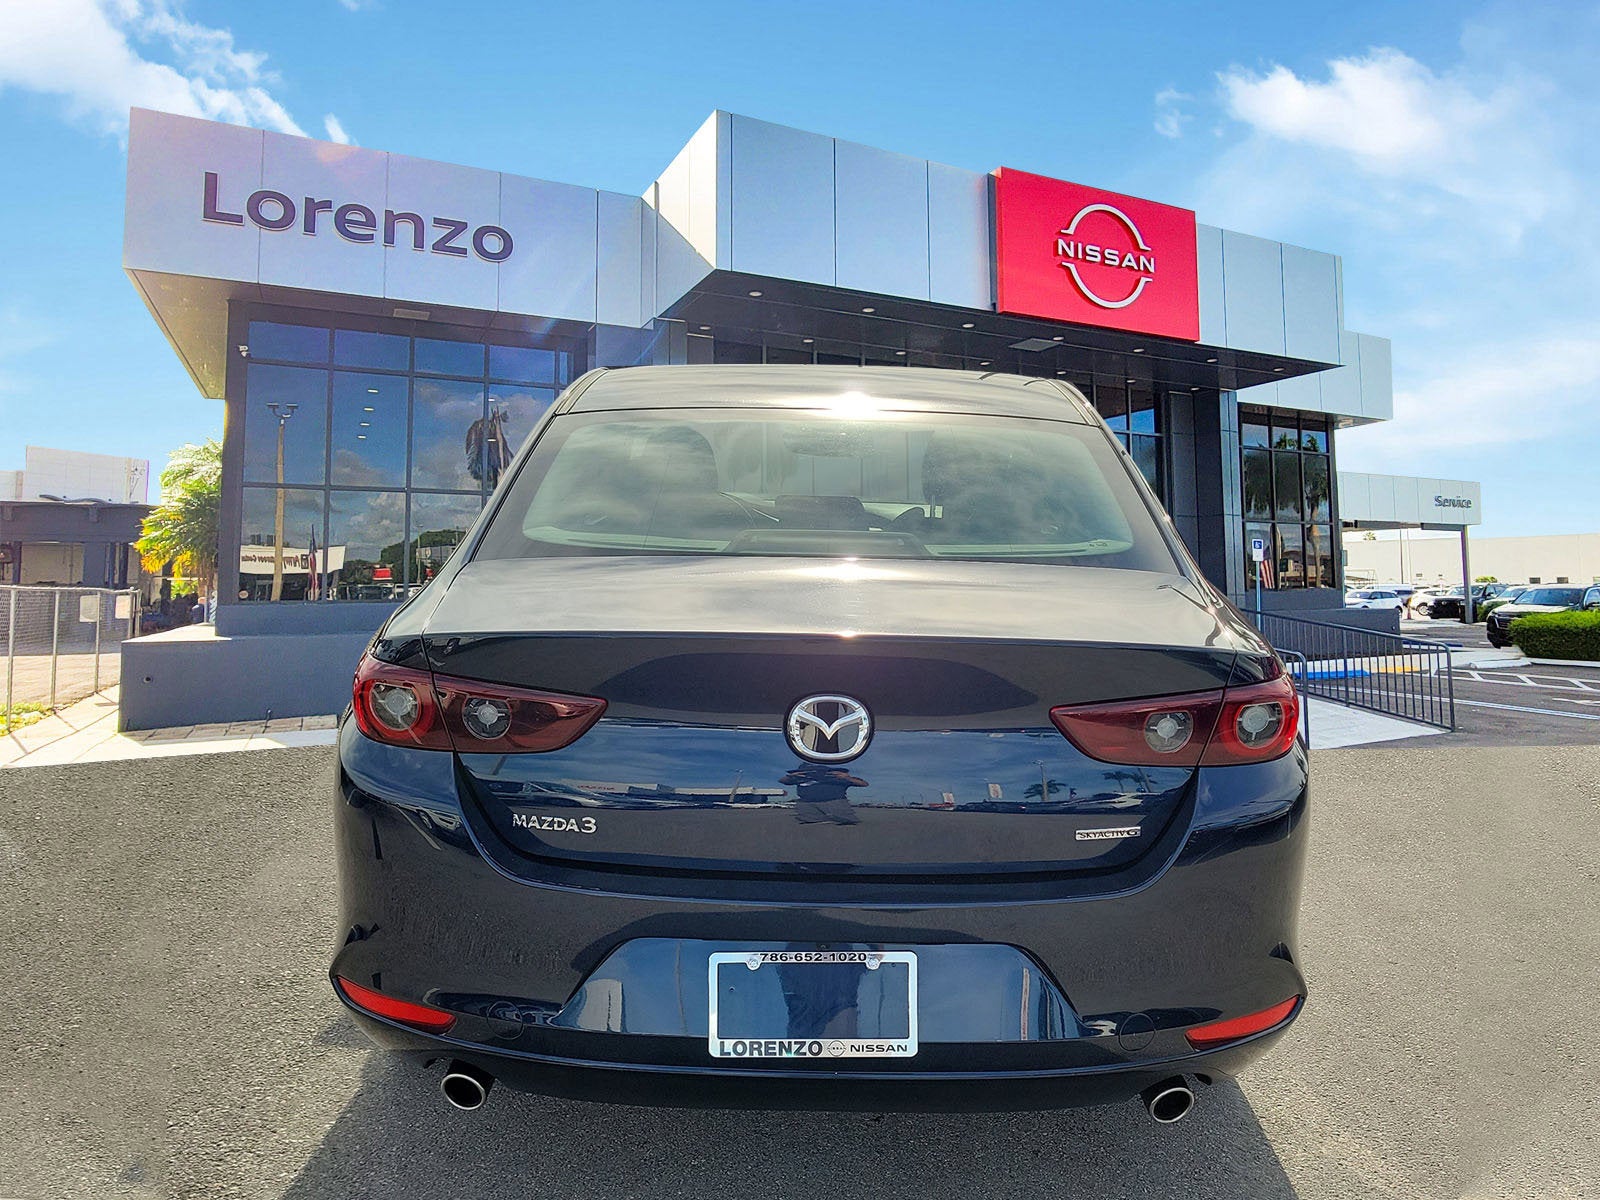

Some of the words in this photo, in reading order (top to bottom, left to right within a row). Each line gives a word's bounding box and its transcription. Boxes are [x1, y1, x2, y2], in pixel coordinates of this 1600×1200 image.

[202, 171, 514, 262] Lorenzo
[1057, 238, 1155, 273] NISSAN
[1434, 495, 1472, 509] Service
[759, 952, 868, 962] 786-652-1020
[719, 1040, 823, 1057] LORENZO
[850, 1044, 908, 1053] NISSAN
